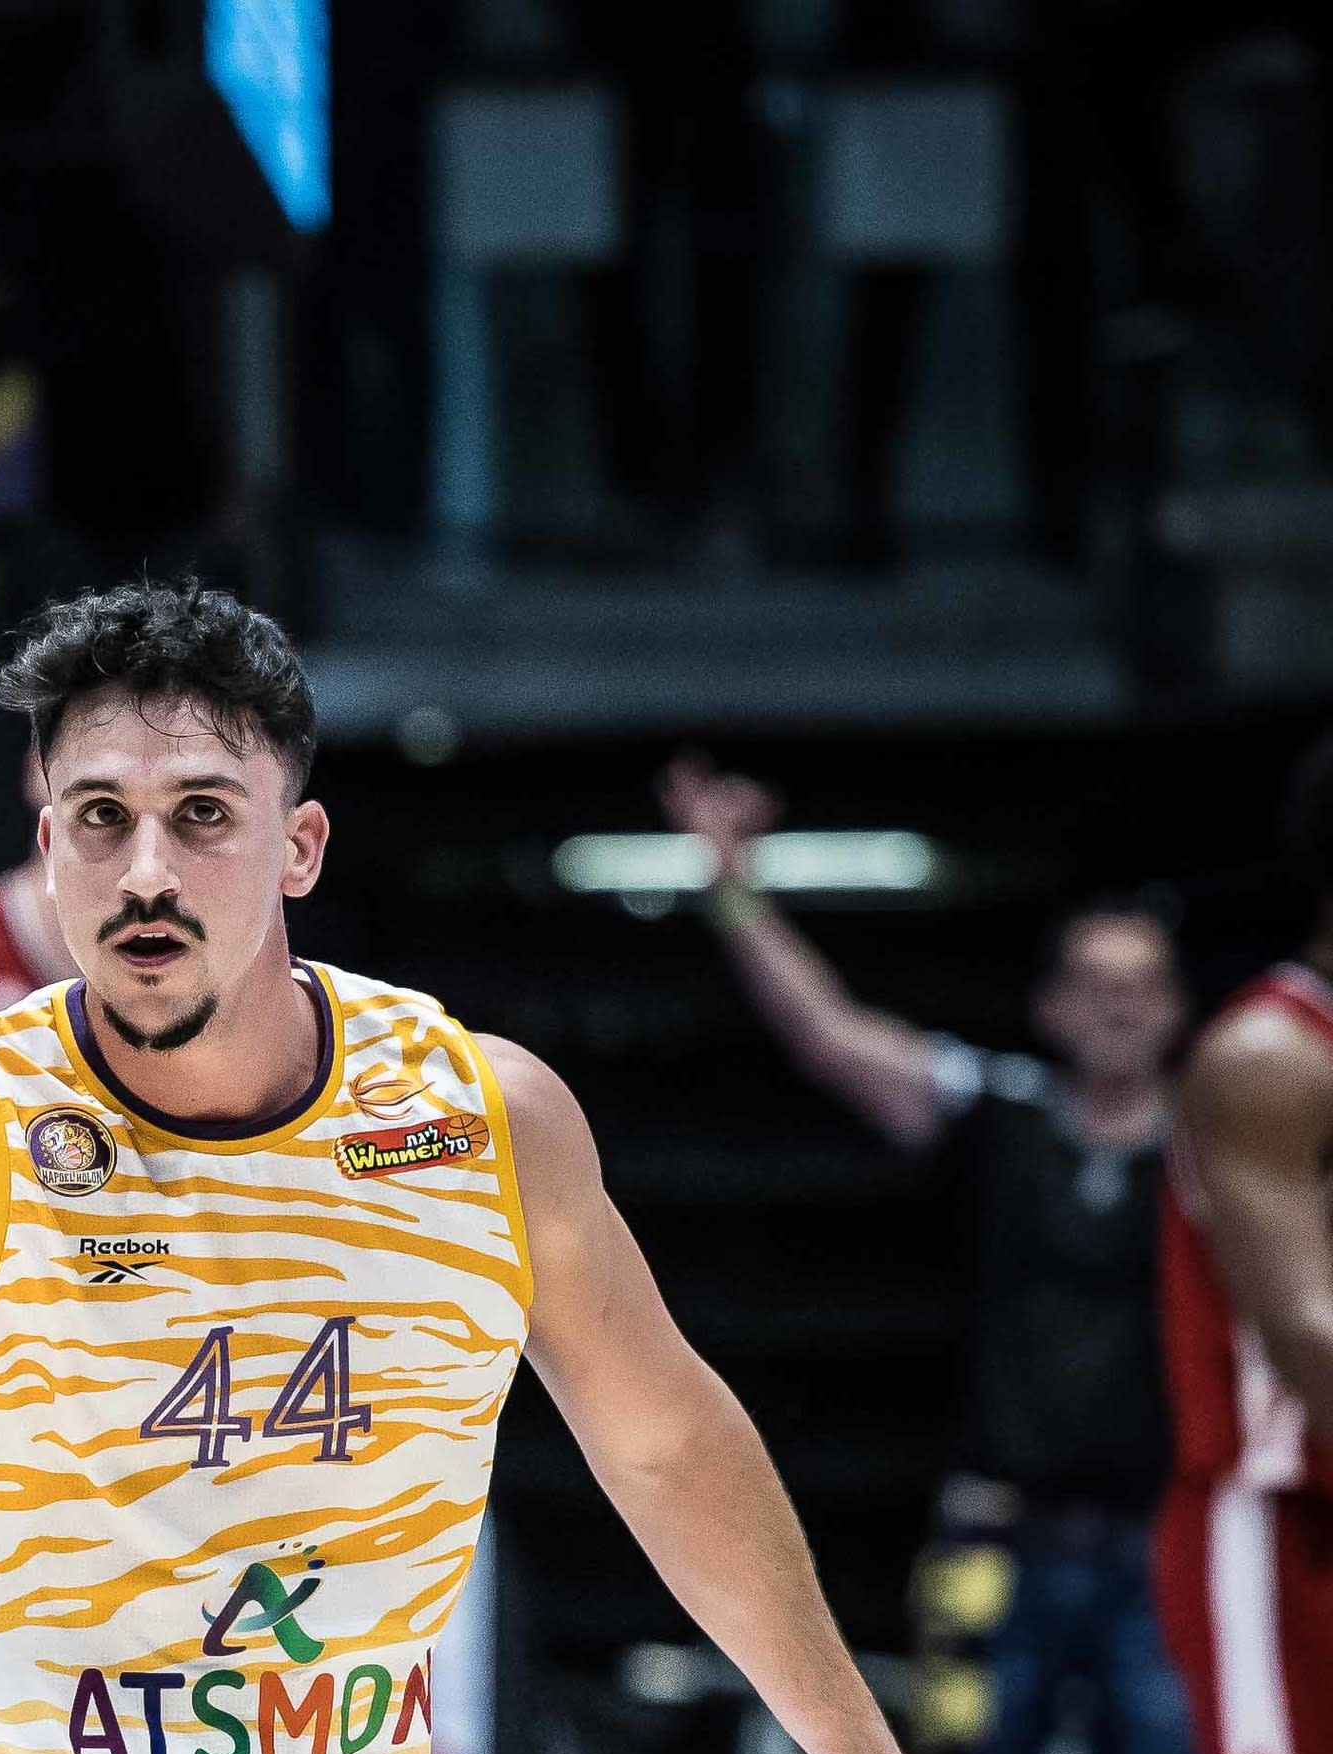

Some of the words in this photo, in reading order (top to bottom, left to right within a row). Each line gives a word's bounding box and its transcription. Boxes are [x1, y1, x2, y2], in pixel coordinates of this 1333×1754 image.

[405, 1125, 439, 1148] ליגת
[346, 1141, 444, 1171] Winner
[41, 1169, 74, 1184] HAPOEL
[76, 1169, 103, 1185] HOLON
[79, 1238, 170, 1257] Reebok
[139, 1316, 372, 1469] 44
